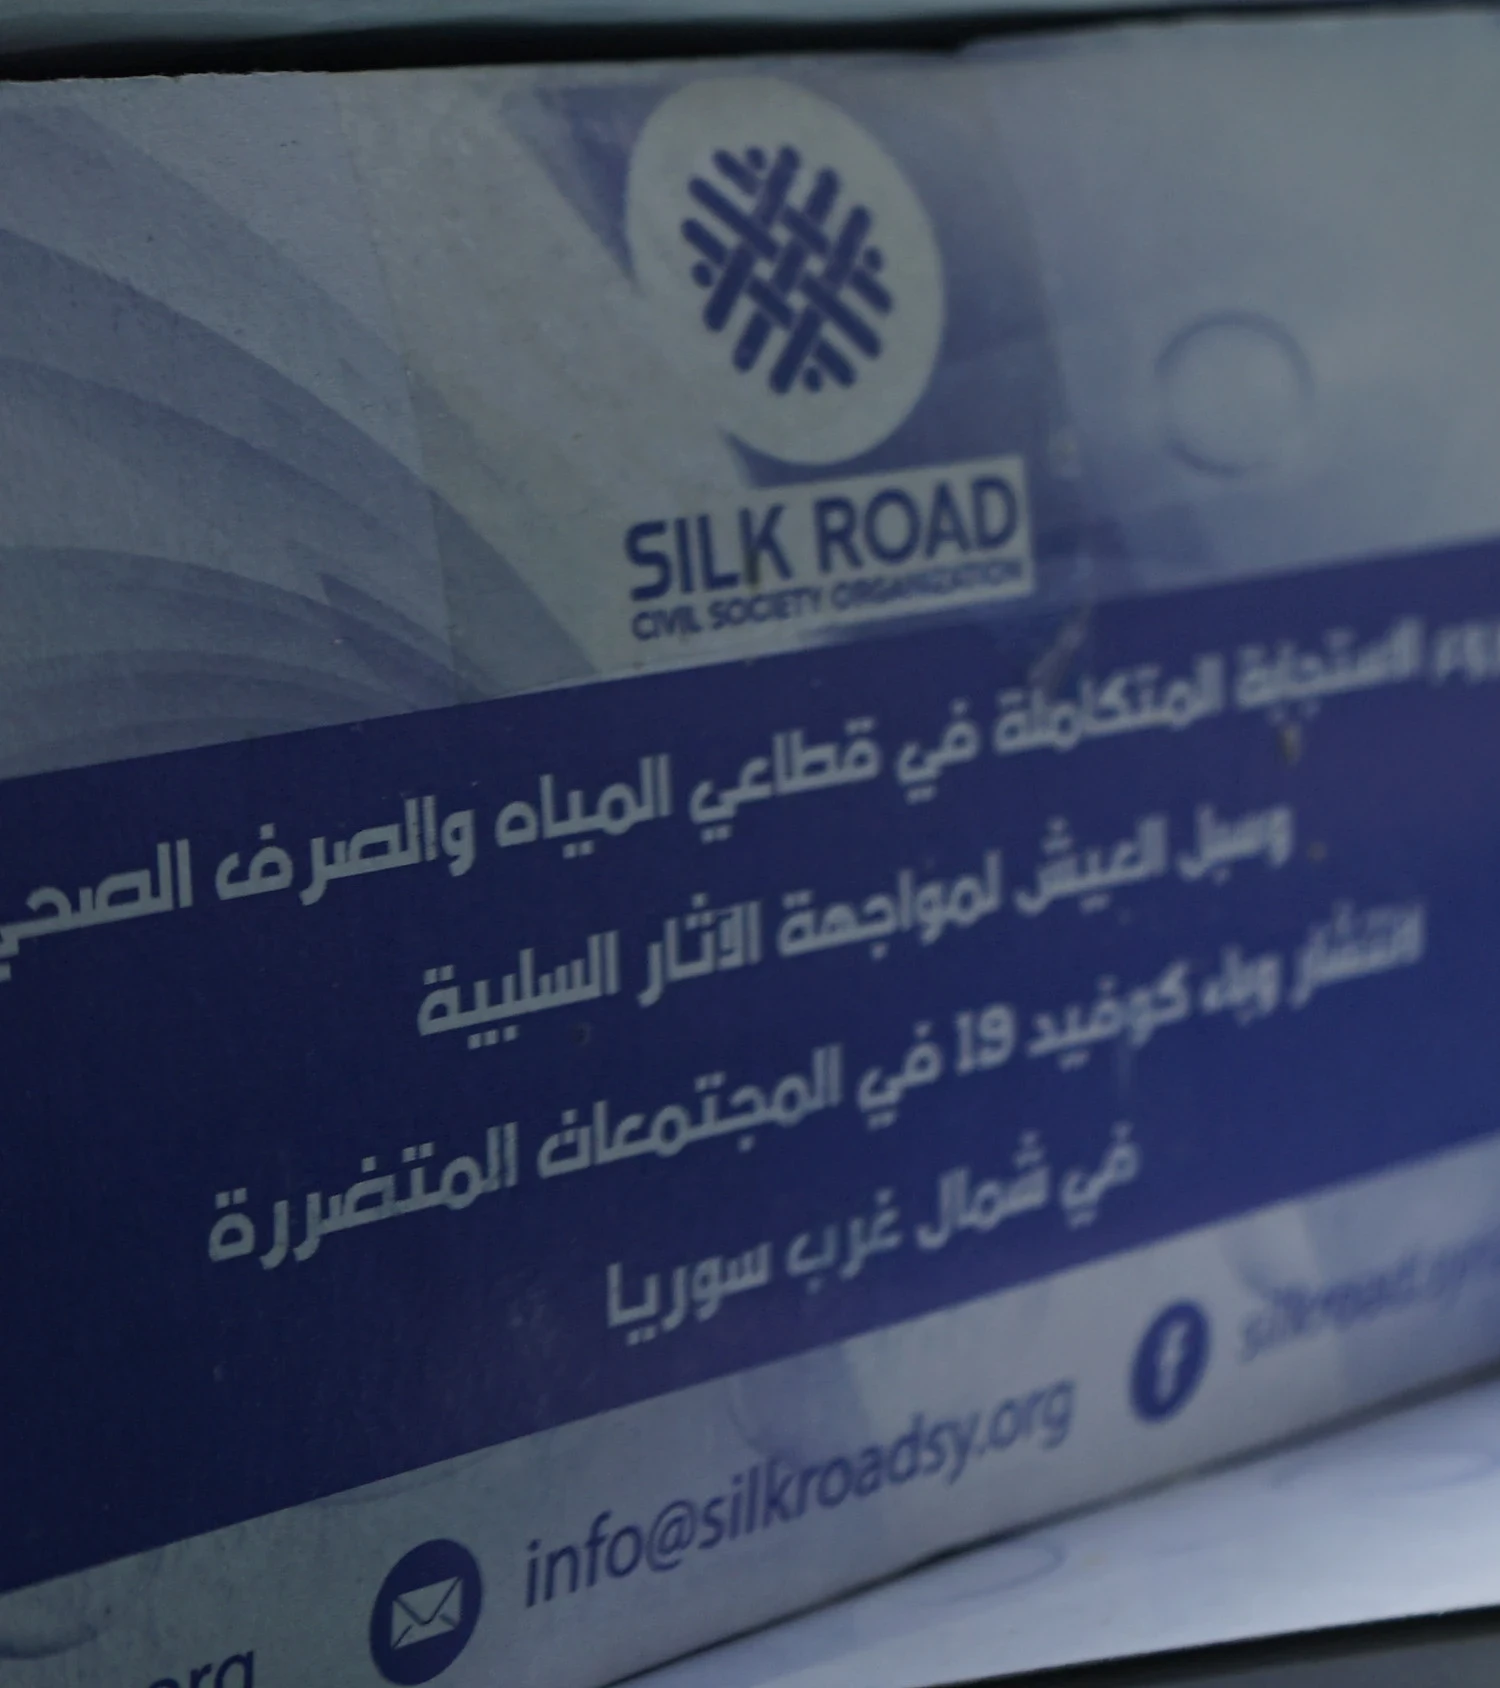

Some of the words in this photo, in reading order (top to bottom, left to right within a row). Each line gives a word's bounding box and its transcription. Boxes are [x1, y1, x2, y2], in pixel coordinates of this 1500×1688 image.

[624, 502, 793, 602] SILK
[812, 473, 1019, 574] ROAD
[630, 603, 704, 642] CIVIL
[708, 584, 824, 632] SOCIETY
[896, 700, 981, 803] في
[992, 653, 1226, 753] المتكاملة
[495, 753, 672, 859] المياه
[690, 717, 881, 843] قطاعي
[214, 795, 476, 905] والصرف
[1014, 815, 1170, 915] العيش
[777, 849, 1002, 961] لمواجهة
[417, 930, 621, 1050] السلبية
[954, 1002, 1016, 1075] 19
[1026, 959, 1192, 1070] كوفيد
[537, 1043, 844, 1180] المجتمعات
[857, 1021, 943, 1130] في
[208, 1121, 520, 1271] المتضررة
[916, 1128, 1050, 1250] شمال
[1060, 1120, 1140, 1228] في
[606, 1242, 773, 1346] سوريا
[787, 1187, 902, 1294] غرب
[524, 1379, 1078, 1609] info@silkroadsy.org
